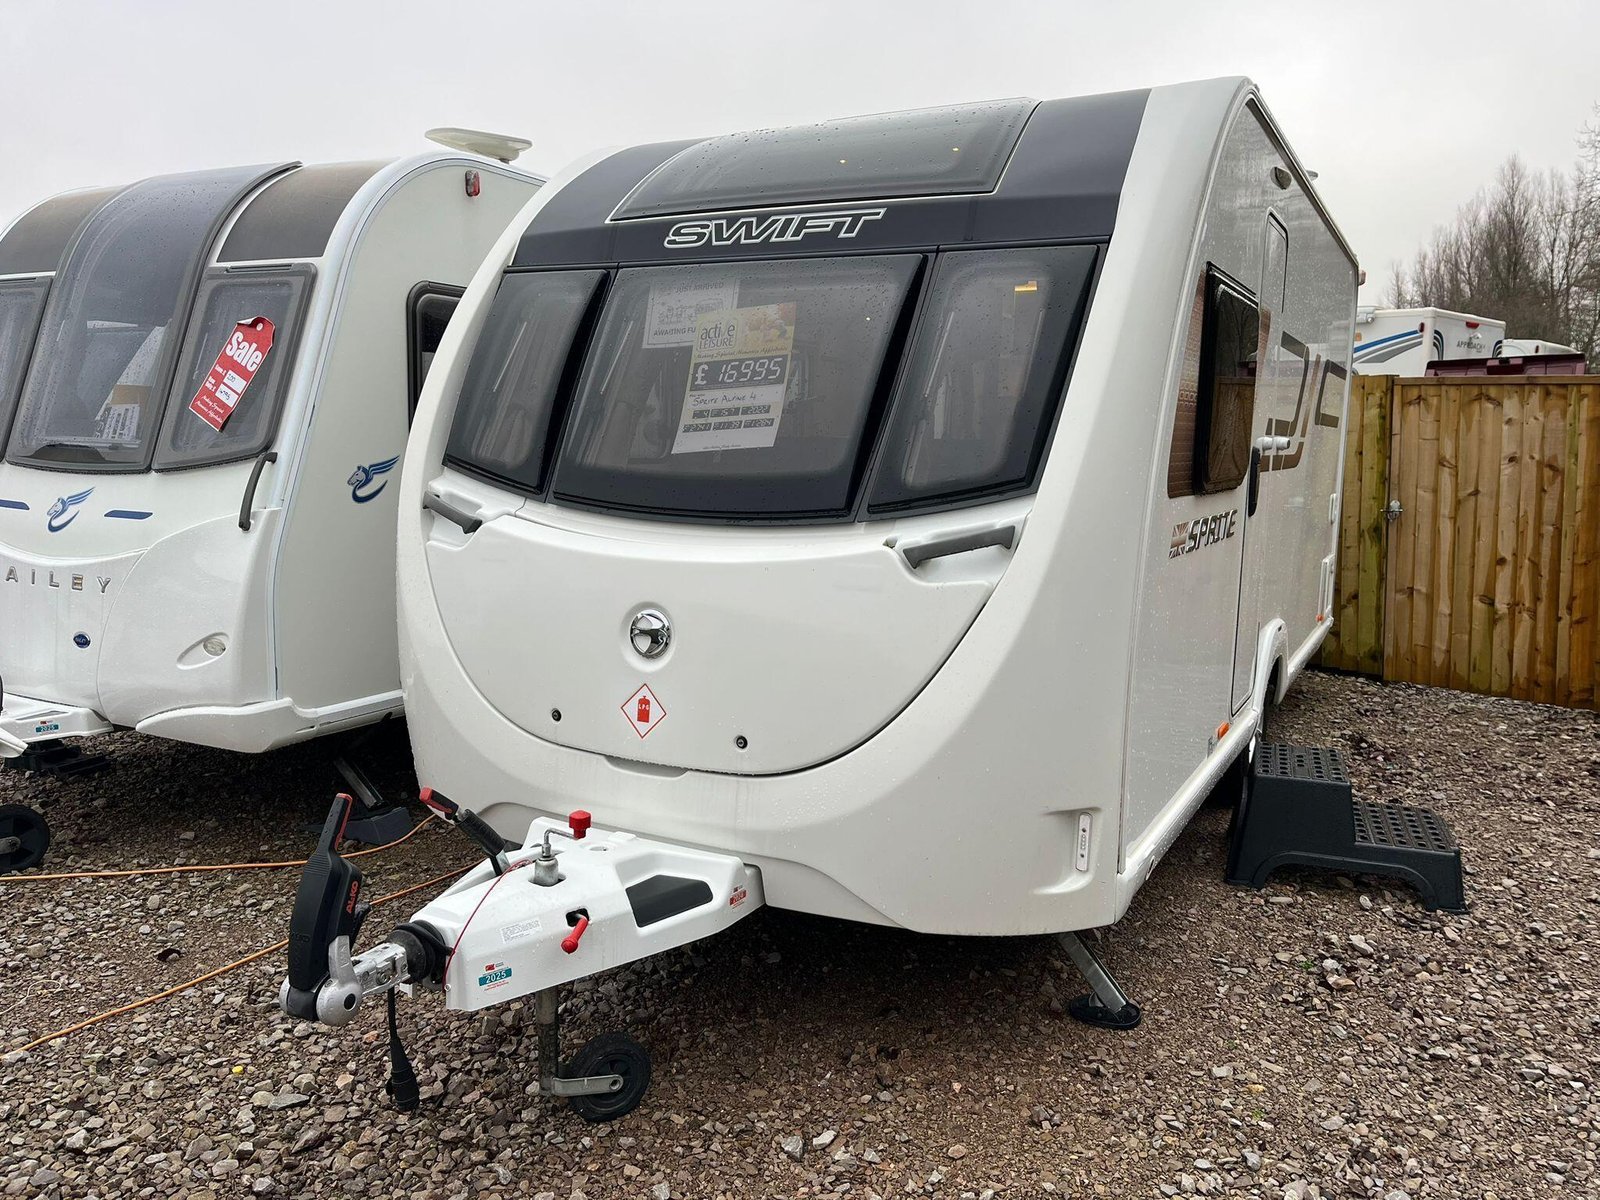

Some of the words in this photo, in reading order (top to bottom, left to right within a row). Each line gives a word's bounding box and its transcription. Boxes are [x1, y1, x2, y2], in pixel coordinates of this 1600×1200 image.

[664, 207, 888, 249] SWIFT
[653, 327, 686, 336] AWAITING
[699, 337, 734, 350] LEISURE
[225, 331, 263, 372] Sale
[718, 357, 783, 383] 16995
[1186, 509, 1238, 553] SPRITE
[485, 970, 507, 984] 2025
